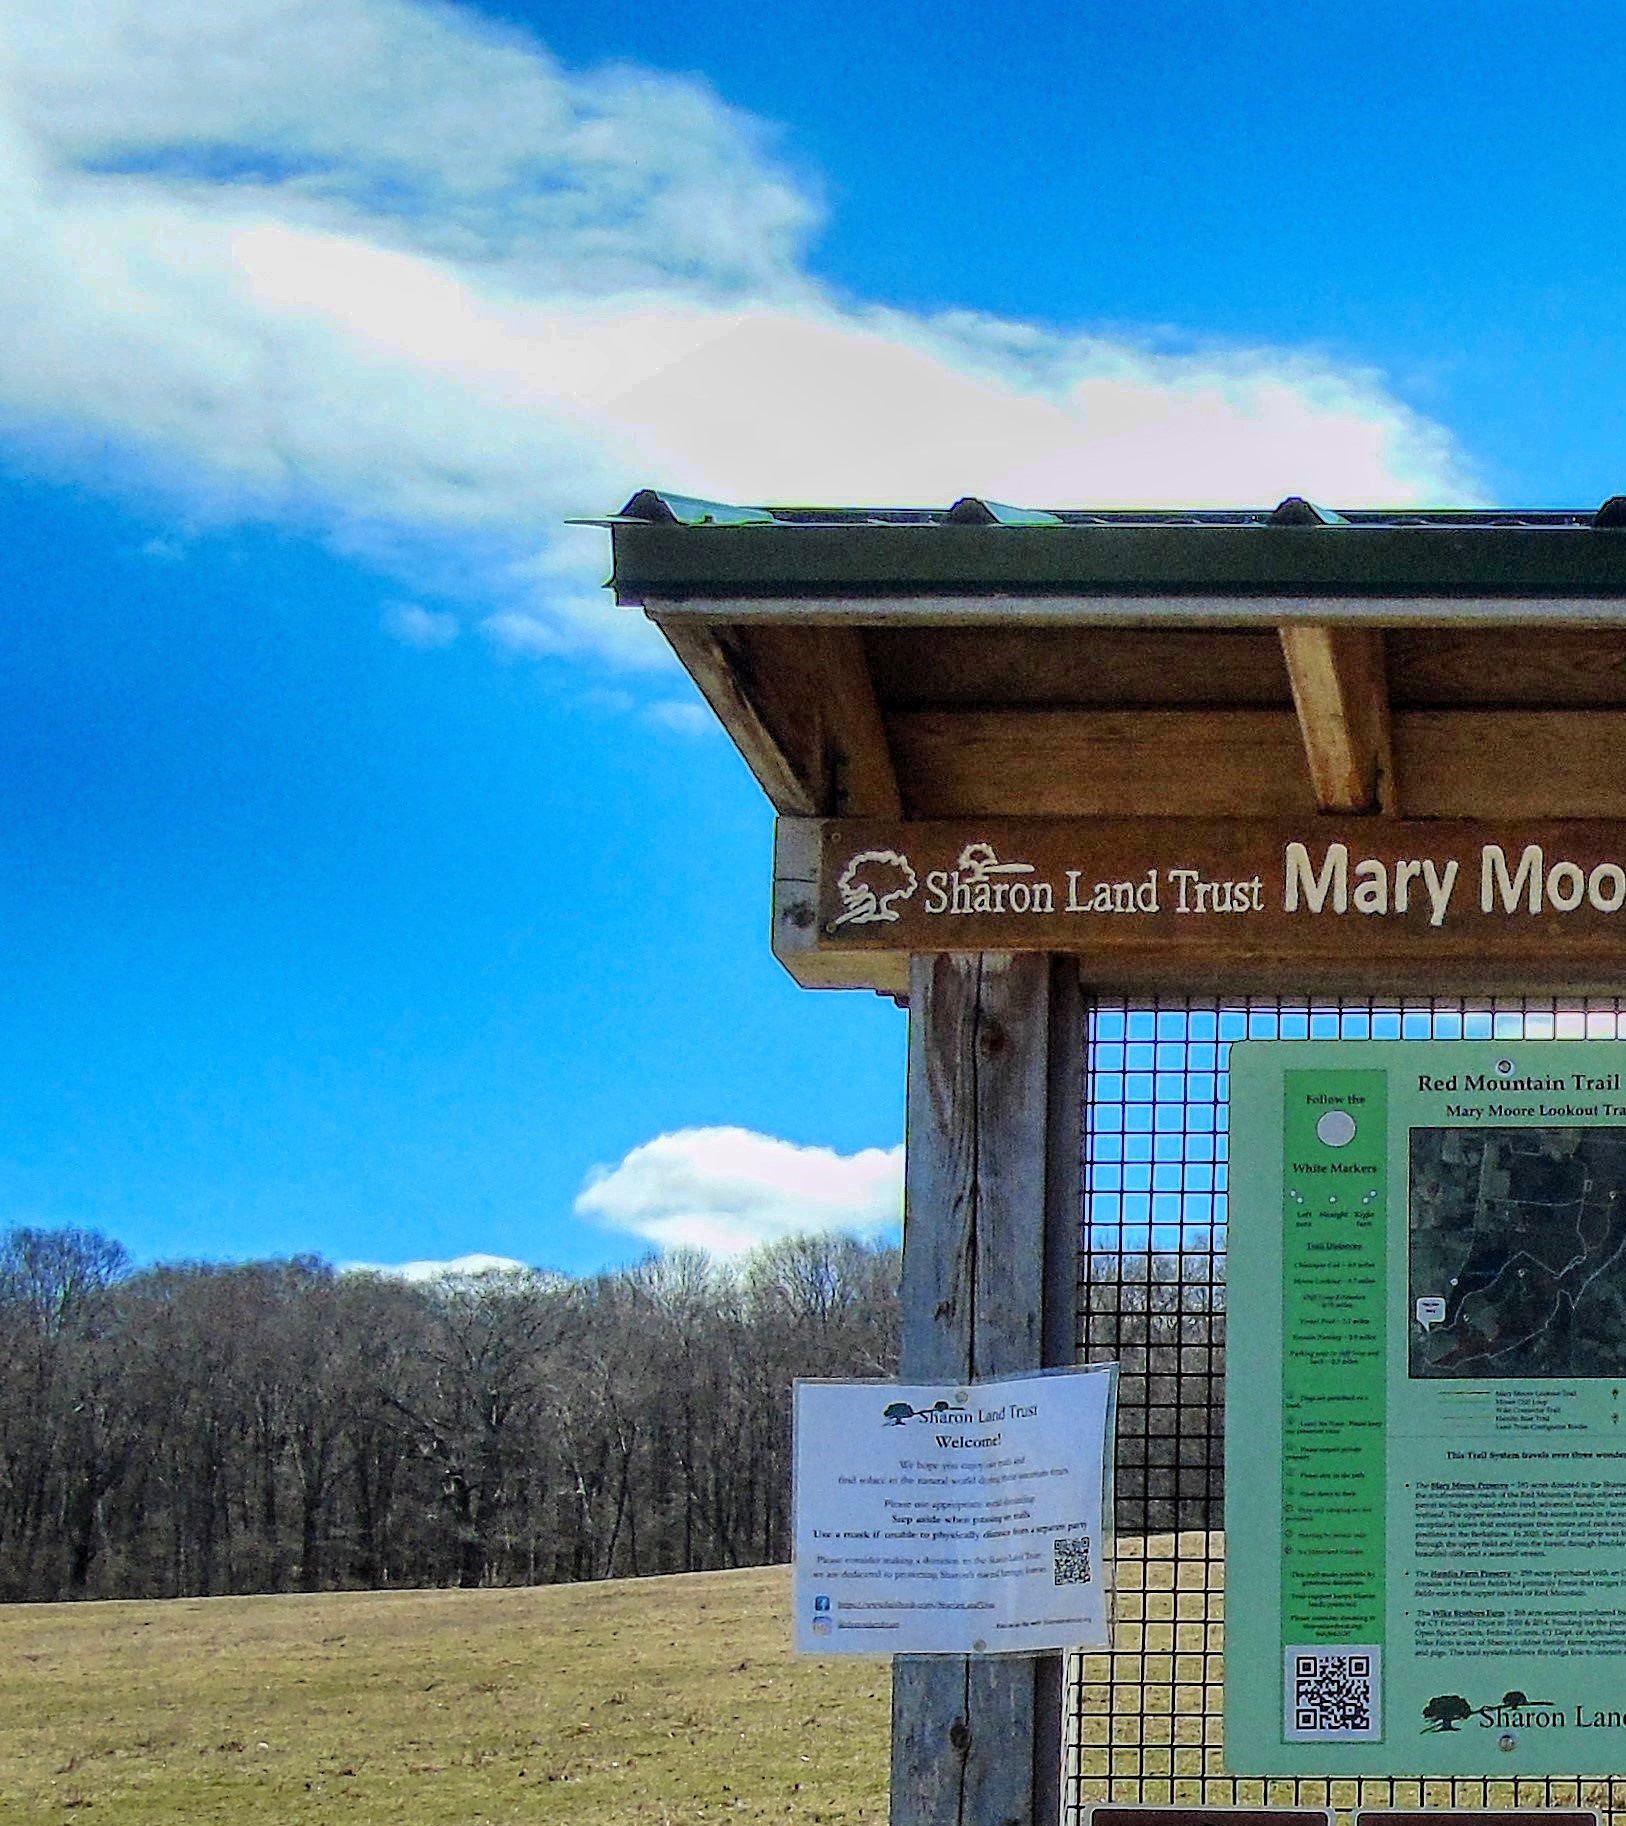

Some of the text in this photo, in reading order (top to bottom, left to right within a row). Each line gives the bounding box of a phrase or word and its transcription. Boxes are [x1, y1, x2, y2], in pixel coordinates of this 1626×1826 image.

[924, 869, 1265, 915] Sharon Land Trust
[1284, 843, 1459, 927] Mary
[1418, 1075, 1457, 1091] Red
[1465, 1075, 1565, 1091] Mountain
[1572, 1074, 1620, 1091] Trail
[1306, 1094, 1366, 1104] Follow the
[1446, 1105, 1484, 1120] Mary
[1489, 1104, 1535, 1117] Moore
[1540, 1104, 1598, 1116] Lookout
[1292, 1162, 1377, 1174] White Markers
[918, 1403, 1038, 1424] Sharon Land Trust
[935, 1432, 1002, 1449] Welcome!
[1446, 1451, 1465, 1461] This
[1468, 1451, 1487, 1461] Trail
[1489, 1451, 1520, 1462] System
[1521, 1451, 1550, 1461] travels
[1551, 1451, 1570, 1461] over
[1479, 1706, 1565, 1728] Sharon
